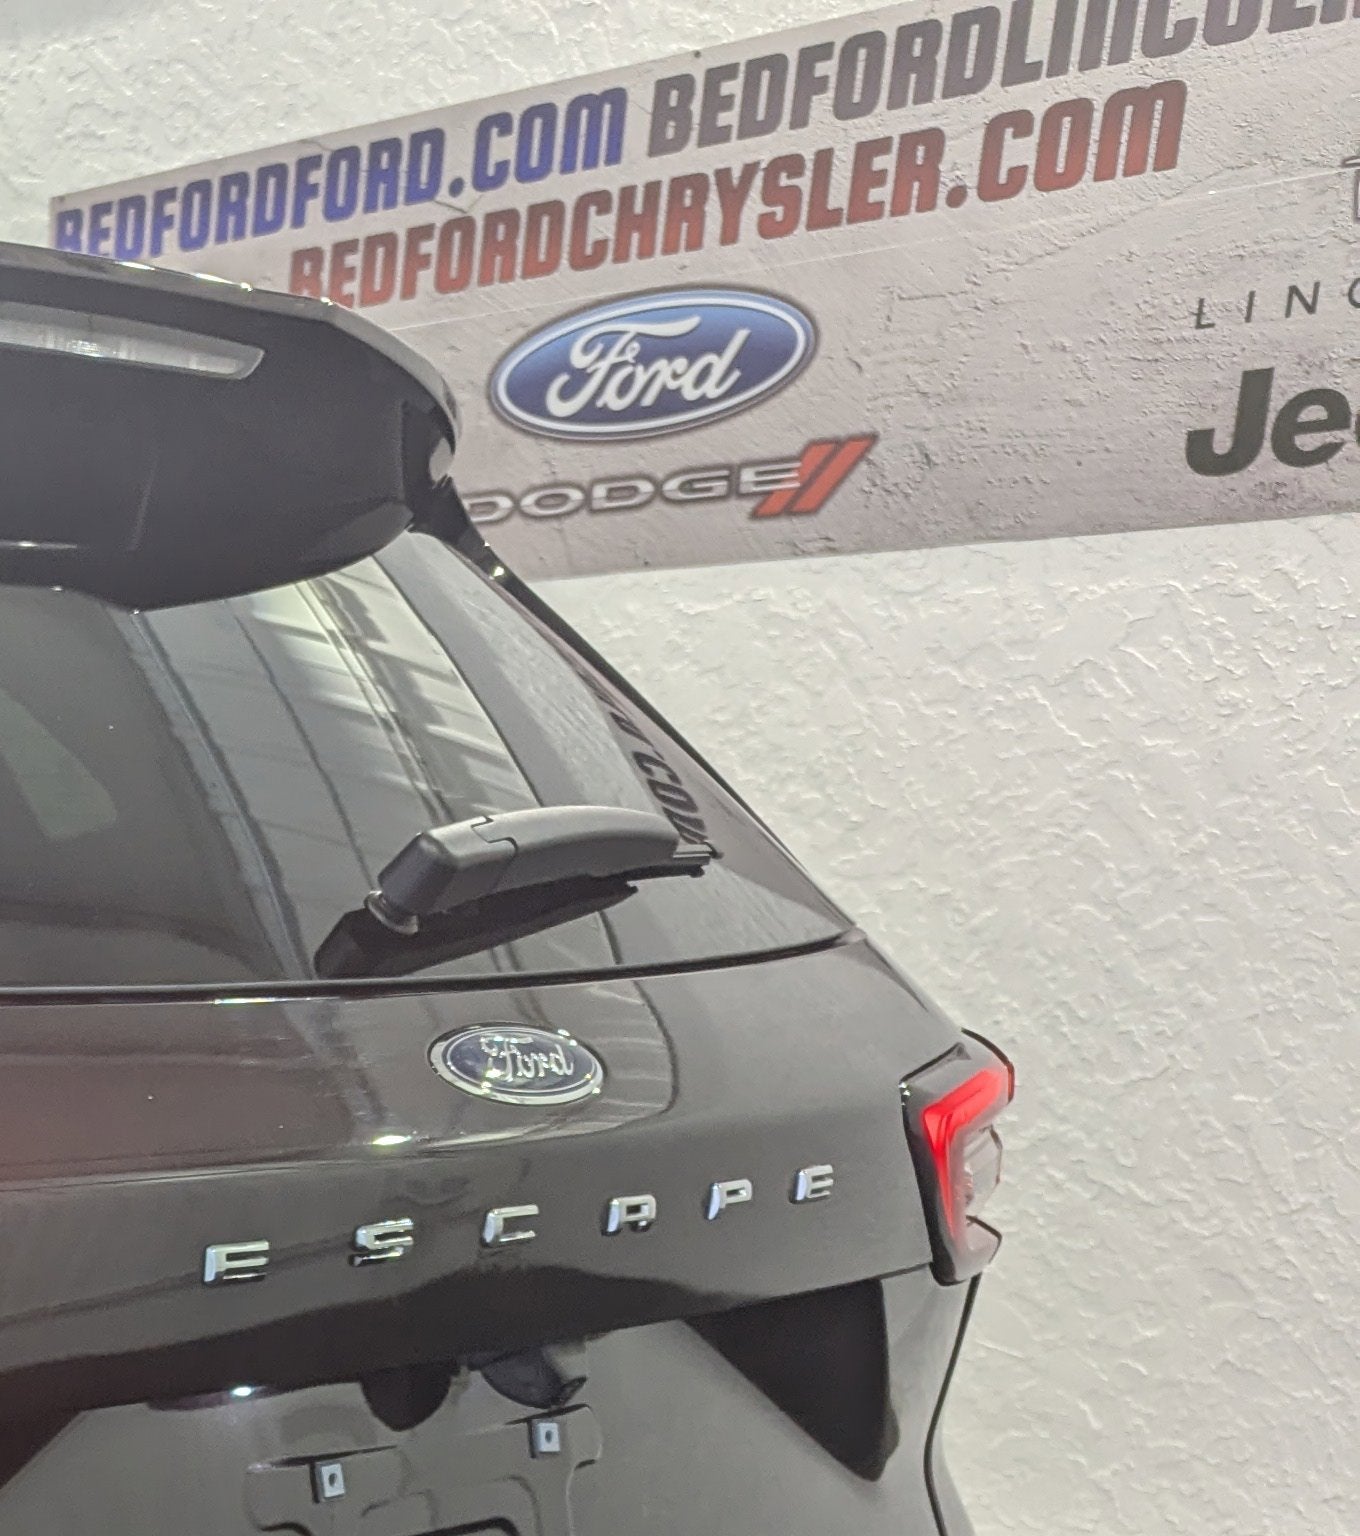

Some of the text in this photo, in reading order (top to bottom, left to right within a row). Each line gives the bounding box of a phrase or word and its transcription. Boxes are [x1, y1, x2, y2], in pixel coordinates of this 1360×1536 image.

[56, 86, 628, 261] BEDFORDFORD.COM
[290, 79, 1189, 309] BEDFORDCHRYSLER.COM
[545, 315, 752, 418] Ford
[467, 460, 803, 523] DODGE
[479, 1034, 575, 1083] Ford
[202, 1164, 835, 1285] ESCAPE
